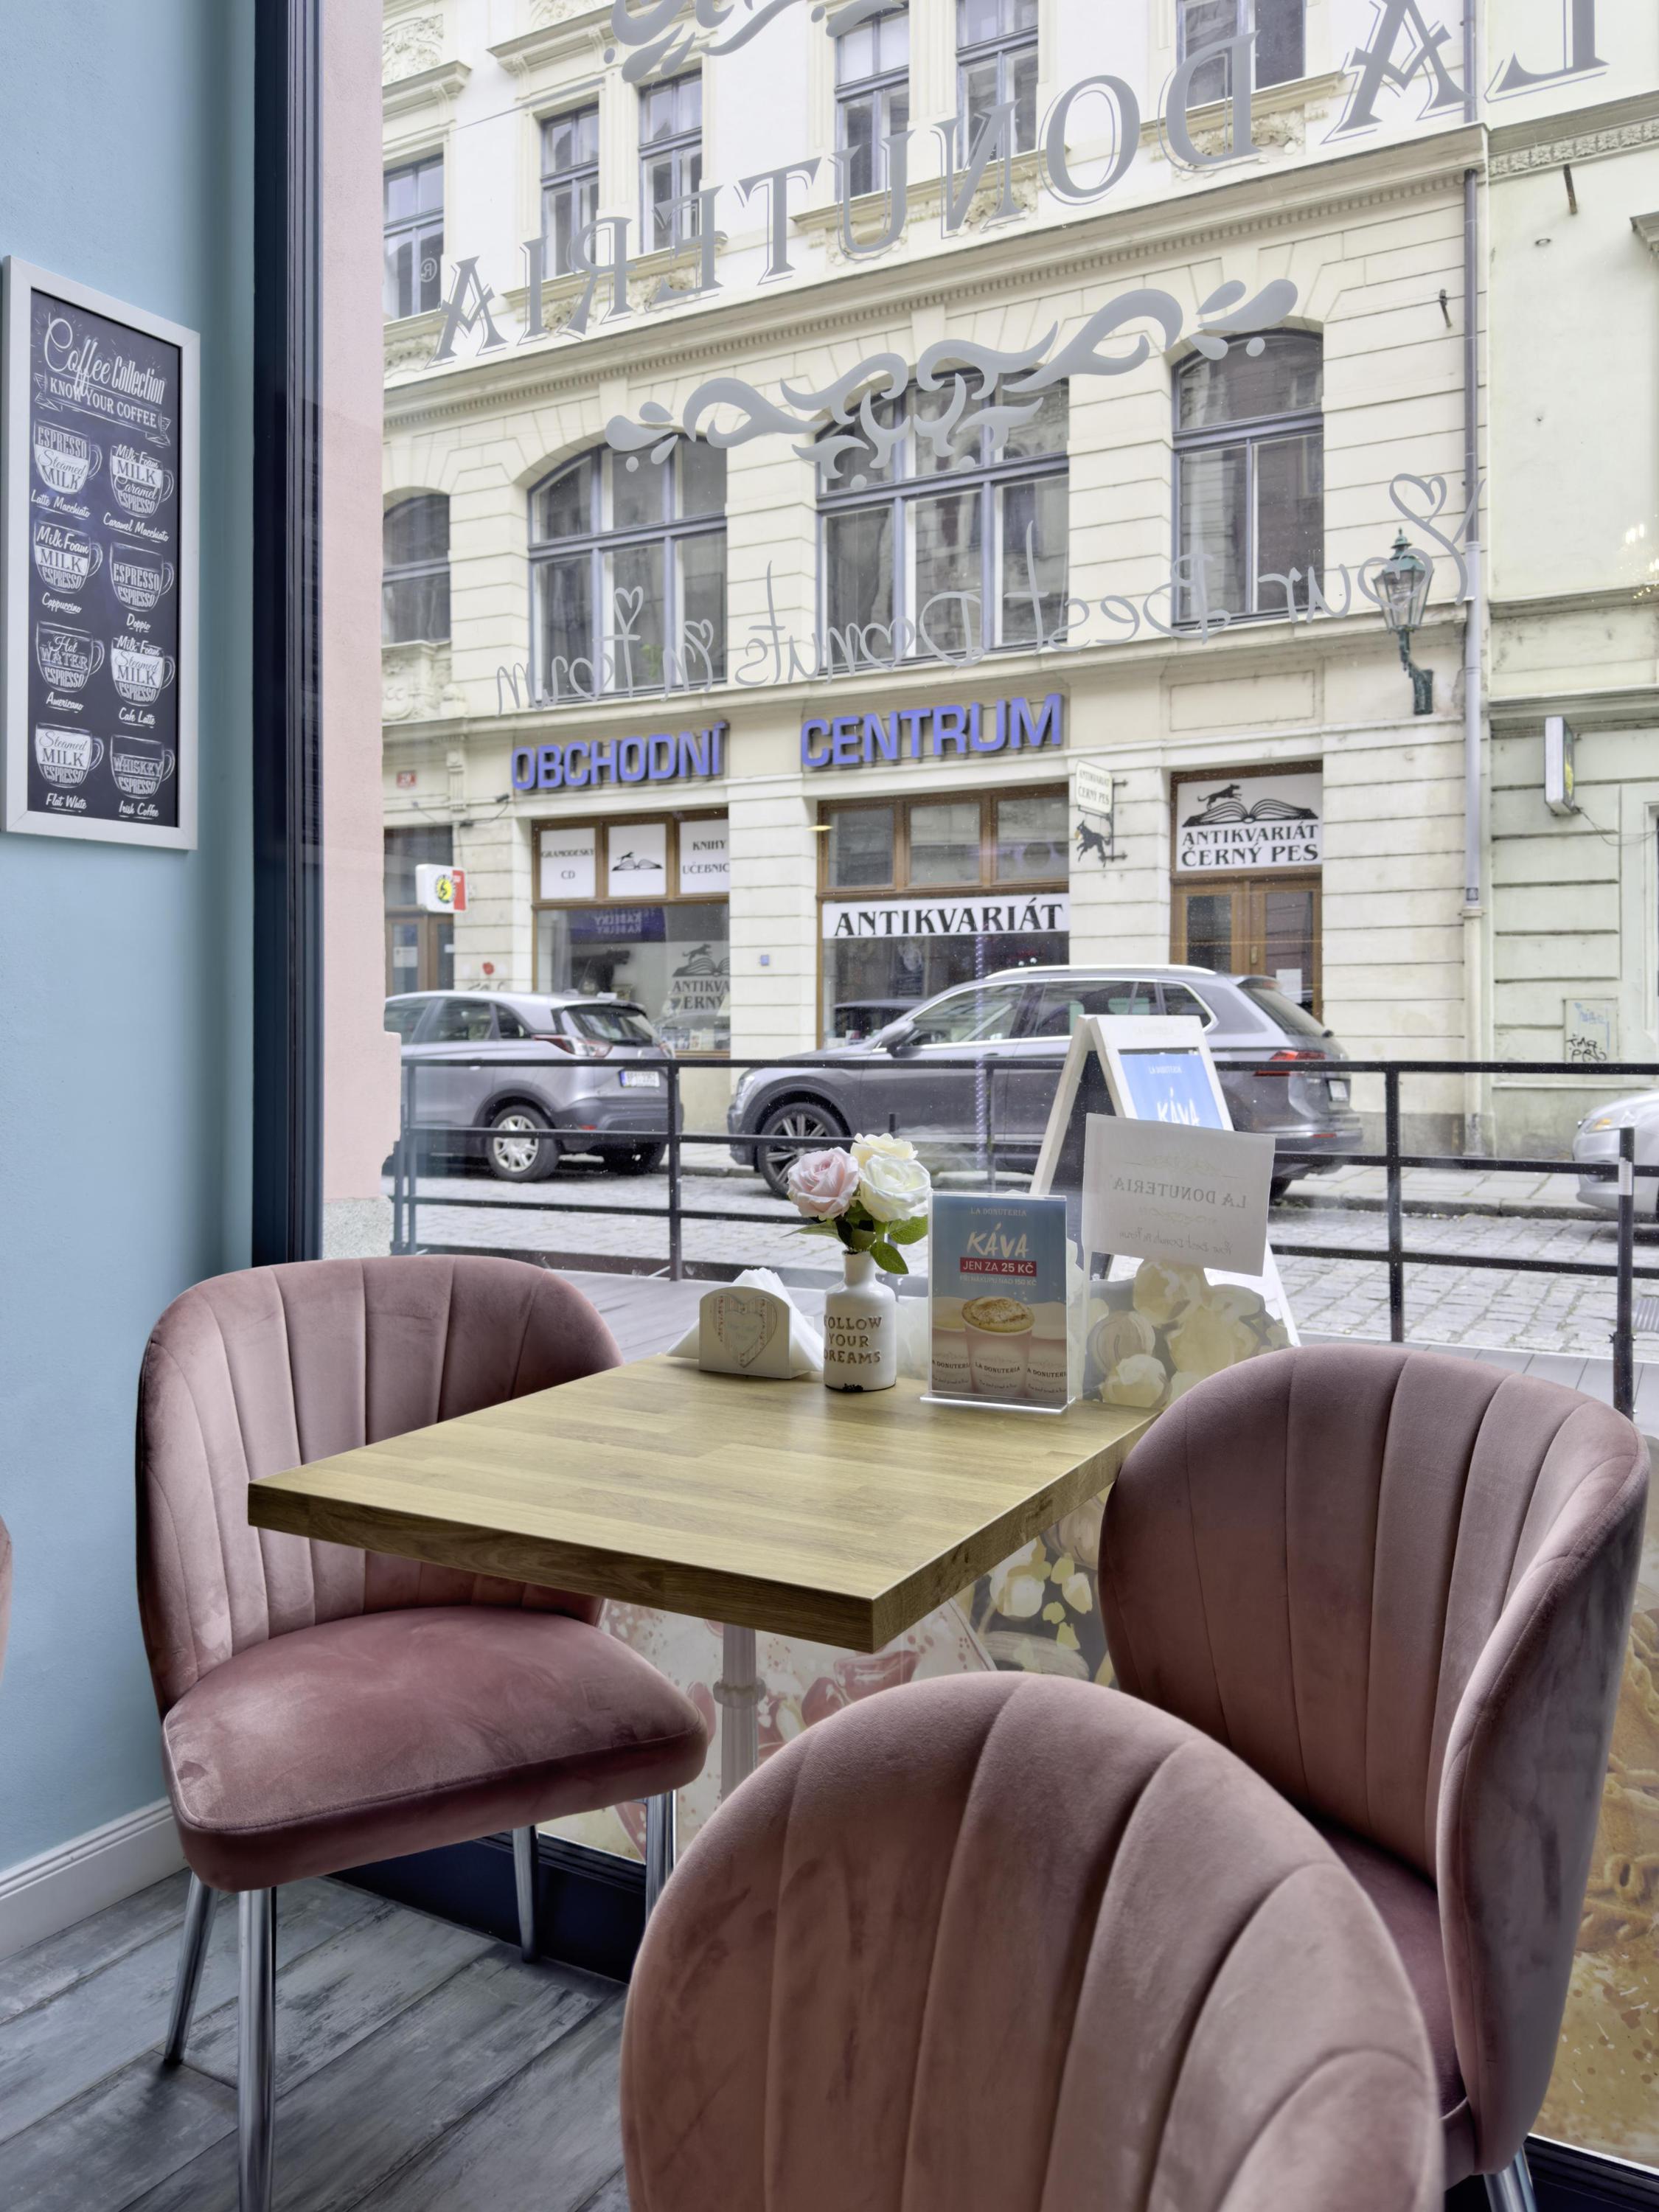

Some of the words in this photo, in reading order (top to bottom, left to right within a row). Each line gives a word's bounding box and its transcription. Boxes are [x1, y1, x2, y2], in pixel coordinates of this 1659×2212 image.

[44, 313, 111, 396] Coffee
[112, 356, 165, 405] Collection
[86, 389, 114, 414] YOUR
[117, 401, 158, 429] COFFEE
[38, 426, 87, 459] ESPRESSO
[38, 450, 88, 475] Steamed
[118, 459, 156, 487] MILK
[41, 465, 81, 490] MILK
[114, 474, 158, 501] Caramel
[30, 489, 51, 507] Latte
[53, 496, 91, 518] Macchiato
[118, 491, 156, 514] ESPRESSO
[102, 512, 134, 532] Caramel
[36, 526, 63, 548] Milk
[63, 532, 89, 554] Foam
[40, 548, 84, 574] MILK
[42, 566, 82, 589] ESPRESSO
[113, 563, 160, 591] ESPRESSO
[118, 585, 156, 608] ESPRESSO
[126, 613, 151, 633] Doppio
[40, 646, 88, 672] WATER
[114, 650, 160, 672] Steamed
[44, 667, 85, 688] ESPRESSO
[117, 665, 158, 687] MILK
[45, 691, 84, 711] Americano
[118, 681, 157, 703] ESPRESSO
[137, 709, 156, 726] Latte
[39, 730, 88, 751] Steamed
[512, 720, 730, 790] OBCHODNÍ
[801, 693, 1064, 768] CENTRUM
[42, 748, 84, 768] MILK
[112, 755, 163, 777] WHISKEY
[43, 765, 84, 784] ESPRESSO
[118, 776, 156, 795] ESPRESSO
[45, 792, 65, 807] Flat
[66, 795, 87, 810] White
[136, 802, 159, 818] Coffee
[1182, 821, 1318, 846] ANTIKVARIÁT
[692, 839, 727, 851] KNIHY
[1181, 843, 1262, 867] ČERNÝ
[1271, 844, 1319, 863] PES
[560, 869, 576, 880] CD
[834, 896, 1063, 938] ANTIKVARIÁT
[983, 1208, 1027, 1217] DONUTERIA
[967, 1222, 1030, 1259] KÁVA
[963, 1260, 982, 1271] JEN
[984, 1262, 999, 1272] ZA
[1001, 1262, 1015, 1273] 25
[1018, 1262, 1034, 1274] KČ
[829, 1333, 869, 1348] YOUR
[984, 1366, 1020, 1374] DONUTERIA
